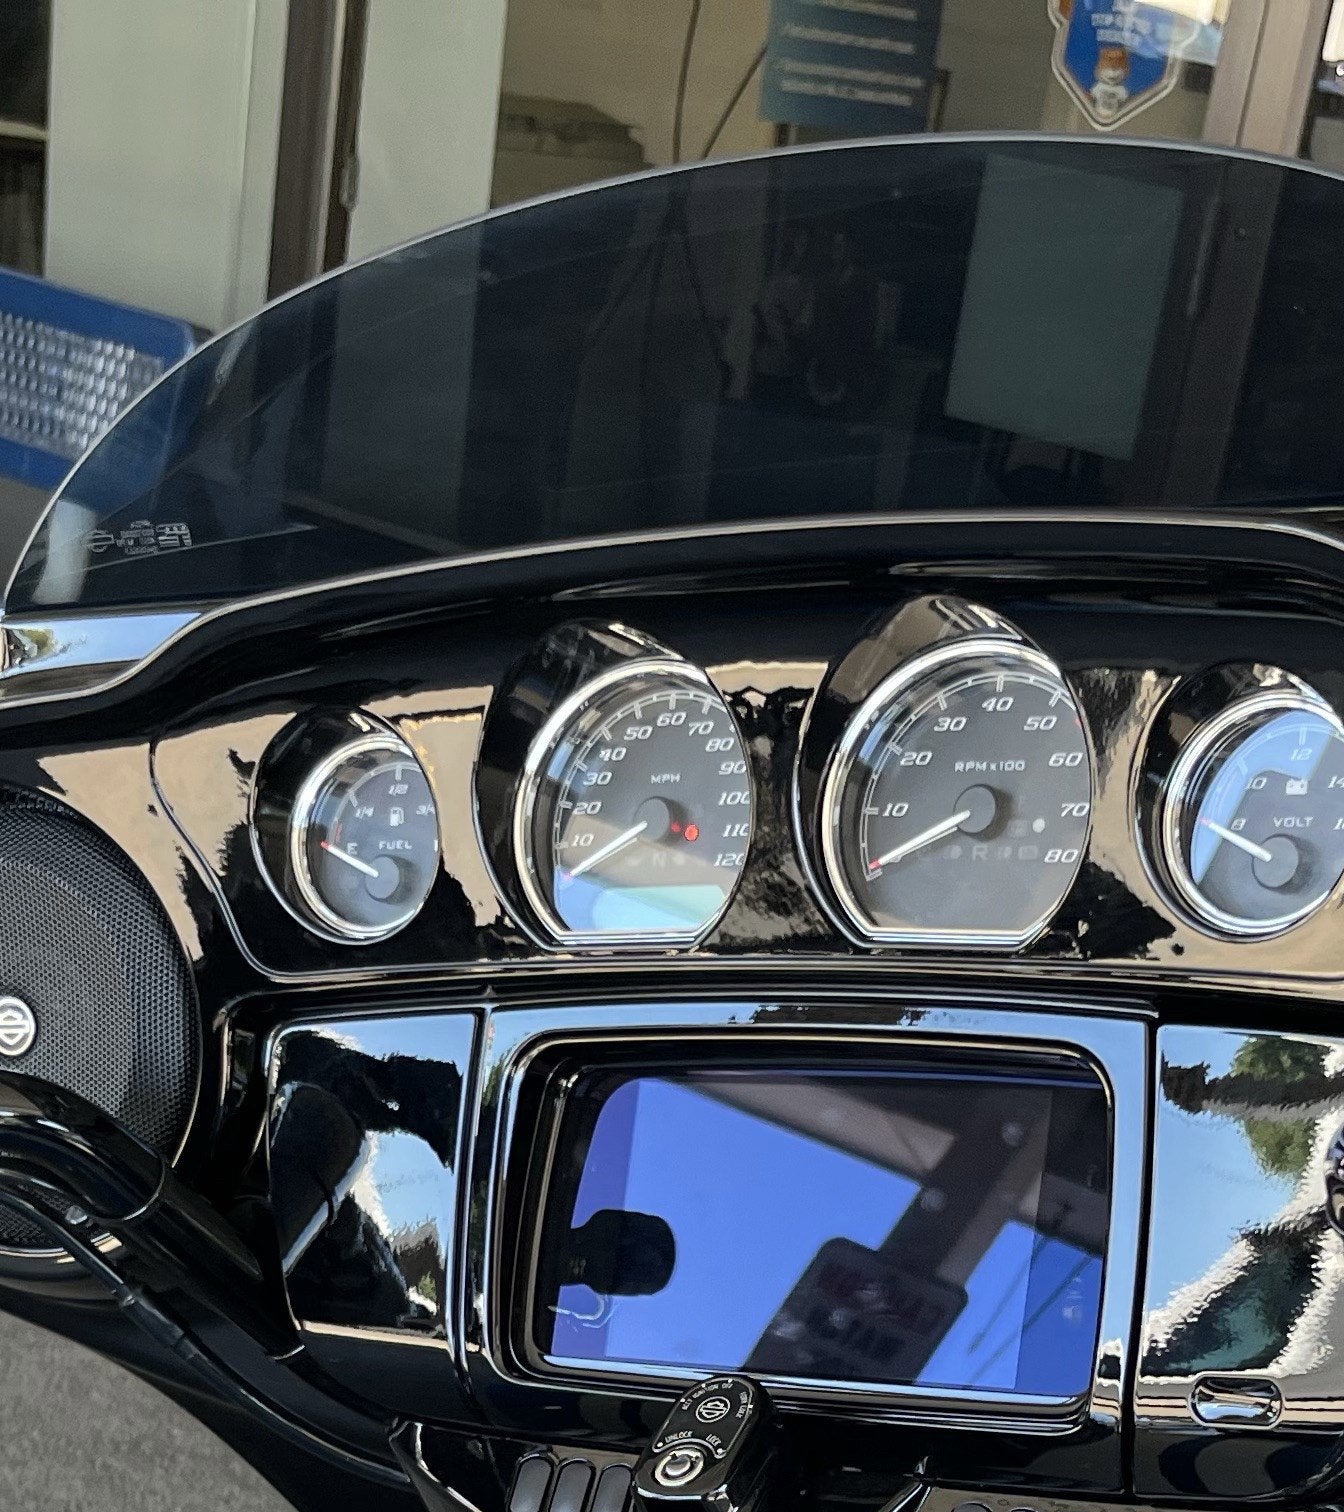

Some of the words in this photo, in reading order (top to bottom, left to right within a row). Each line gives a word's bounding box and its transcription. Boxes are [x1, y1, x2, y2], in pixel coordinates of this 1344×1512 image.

[981, 697, 1015, 712] 40
[656, 712, 687, 727] 60
[933, 717, 968, 732] 30
[1023, 716, 1058, 731] 50
[623, 725, 654, 741] 50
[689, 721, 715, 737] 70
[706, 737, 735, 753] 80
[599, 747, 627, 762] 40
[899, 751, 933, 767] 20
[1048, 752, 1084, 767] 60
[718, 760, 747, 776] 90
[583, 771, 613, 786] 30
[650, 772, 681, 785] MPH
[572, 801, 603, 816] 20
[882, 803, 910, 818] 10
[1060, 802, 1090, 818] 70
[1273, 816, 1314, 828] VOLT
[346, 842, 358, 855] E
[378, 840, 413, 851] FUEL
[571, 834, 595, 848] 10
[1043, 849, 1079, 864] 80
